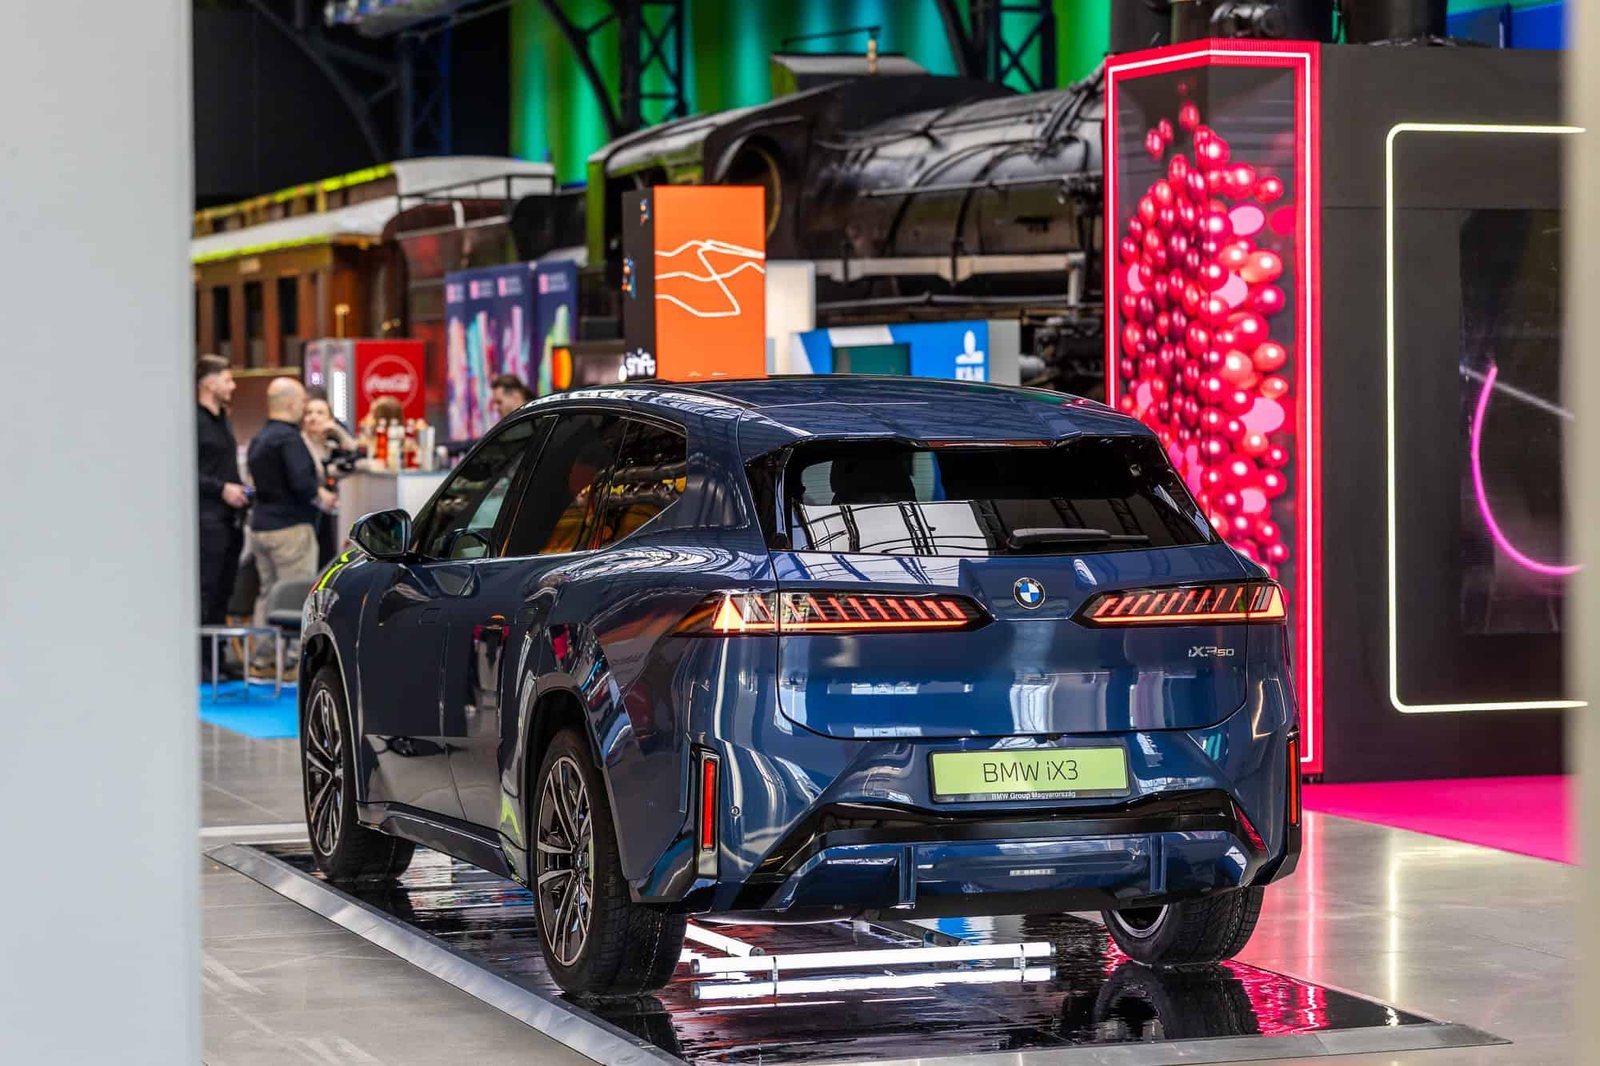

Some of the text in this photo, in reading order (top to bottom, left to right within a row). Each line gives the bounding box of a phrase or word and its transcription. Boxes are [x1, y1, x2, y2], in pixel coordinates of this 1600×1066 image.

[983, 759, 1079, 783] BMW iX3
[1010, 792, 1031, 801] Group
[1031, 790, 1076, 800] Magyarország
